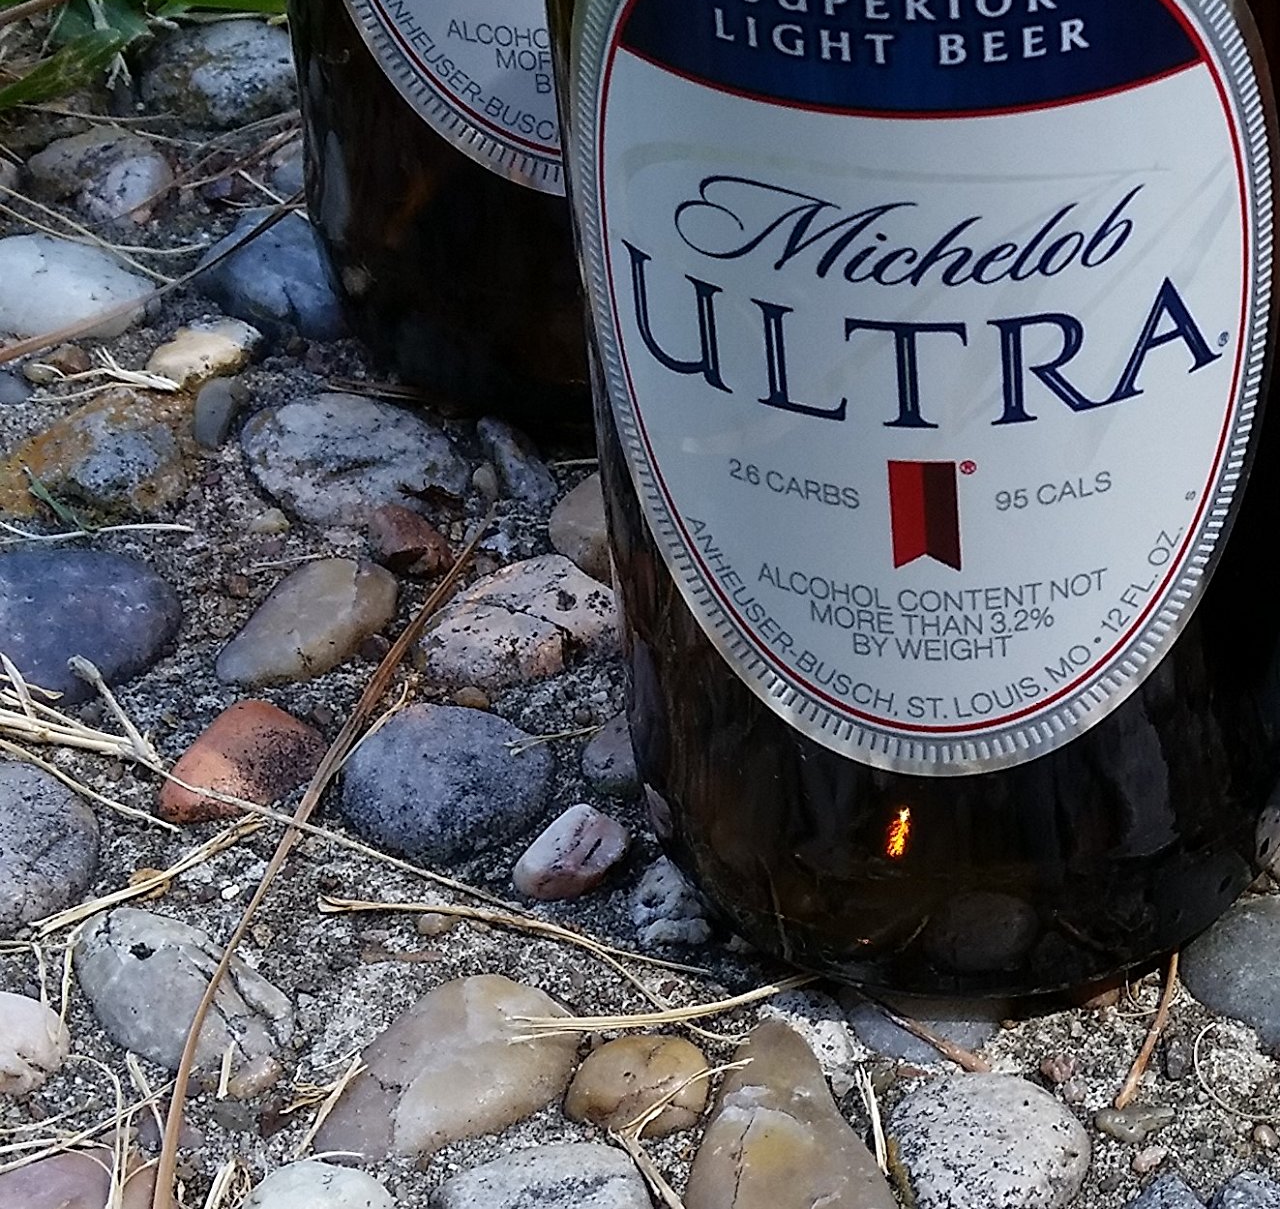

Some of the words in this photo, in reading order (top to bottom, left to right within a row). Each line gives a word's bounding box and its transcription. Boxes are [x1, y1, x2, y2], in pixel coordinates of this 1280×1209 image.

[446, 18, 548, 49] ALCOHO
[714, 7, 895, 65] LIGHT
[938, 18, 1091, 65] BEER
[535, 73, 552, 94] B
[674, 175, 1145, 288] Michelob
[621, 239, 1223, 429] ULTRA
[728, 458, 761, 486] 2.6
[766, 470, 860, 510] CARBS
[995, 488, 1029, 512] 95
[1036, 470, 1113, 506] CALS
[757, 562, 892, 611] ALCOHOL
[897, 582, 1042, 613] CONTENT
[1050, 567, 1109, 603] NOT
[685, 515, 898, 717] ANHEUSER-BUSCH,
[906, 695, 948, 720] ST.
[954, 676, 1049, 719] LOUIS,
[1044, 644, 1092, 684] MO
[1101, 607, 1131, 634] 12
[1120, 574, 1160, 609] FL.
[1147, 525, 1184, 567] OZ.
[809, 600, 895, 635] MORE
[901, 613, 984, 636] THAN
[990, 606, 1055, 635] 3.2%
[852, 633, 888, 657] BY
[895, 634, 1013, 661] WEIGHT
